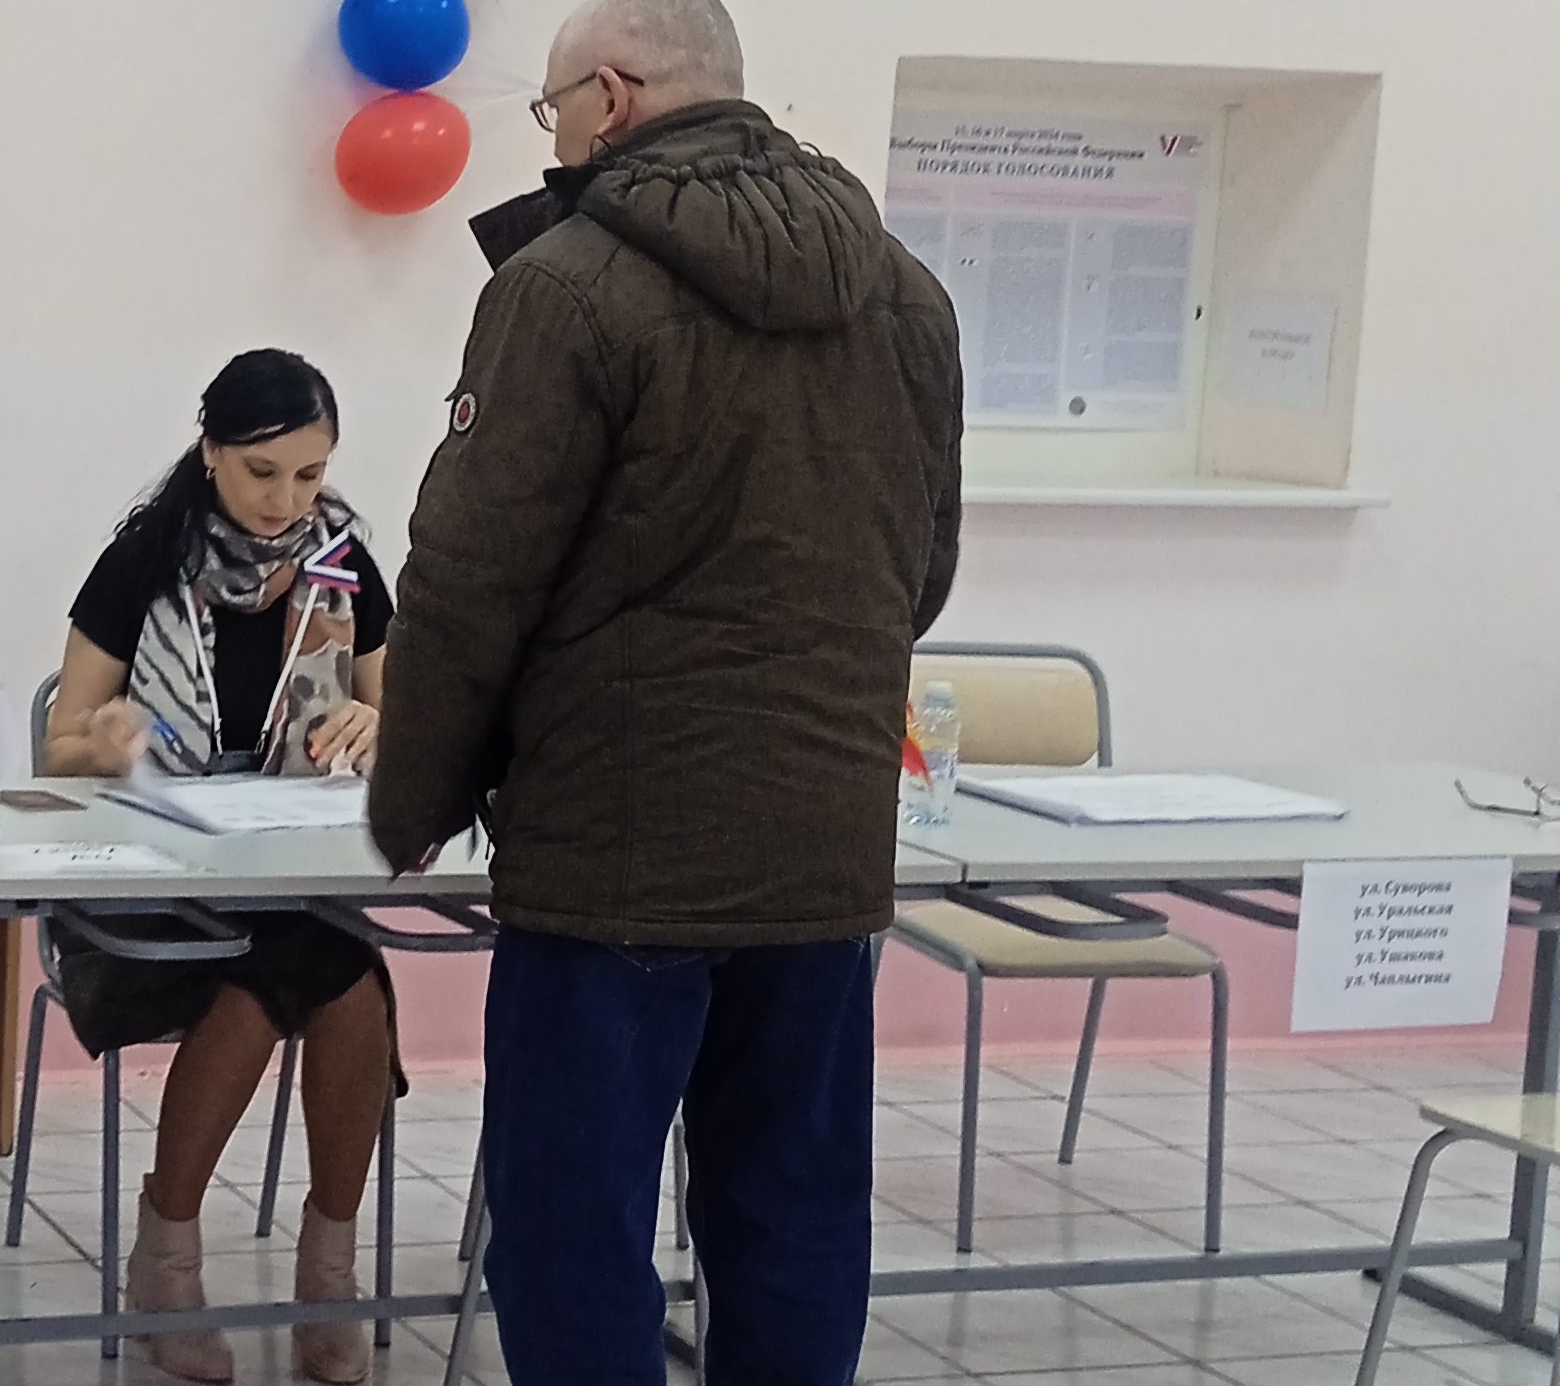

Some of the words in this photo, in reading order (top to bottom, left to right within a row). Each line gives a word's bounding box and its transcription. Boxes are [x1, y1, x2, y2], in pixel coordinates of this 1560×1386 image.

[916, 158, 992, 176] ПОРЯДОК
[996, 162, 1116, 181] ГОЛОСОВАНИЯ
[1360, 883, 1381, 898] ул.
[1385, 880, 1452, 897] Суворова
[1354, 906, 1374, 921] ул.
[1377, 903, 1454, 918] Уральская
[1354, 928, 1376, 943] ул.
[1380, 926, 1448, 942] Урицкого
[1355, 951, 1377, 967] ул.
[1380, 950, 1443, 963] Ушакова
[1344, 974, 1366, 990] ул.
